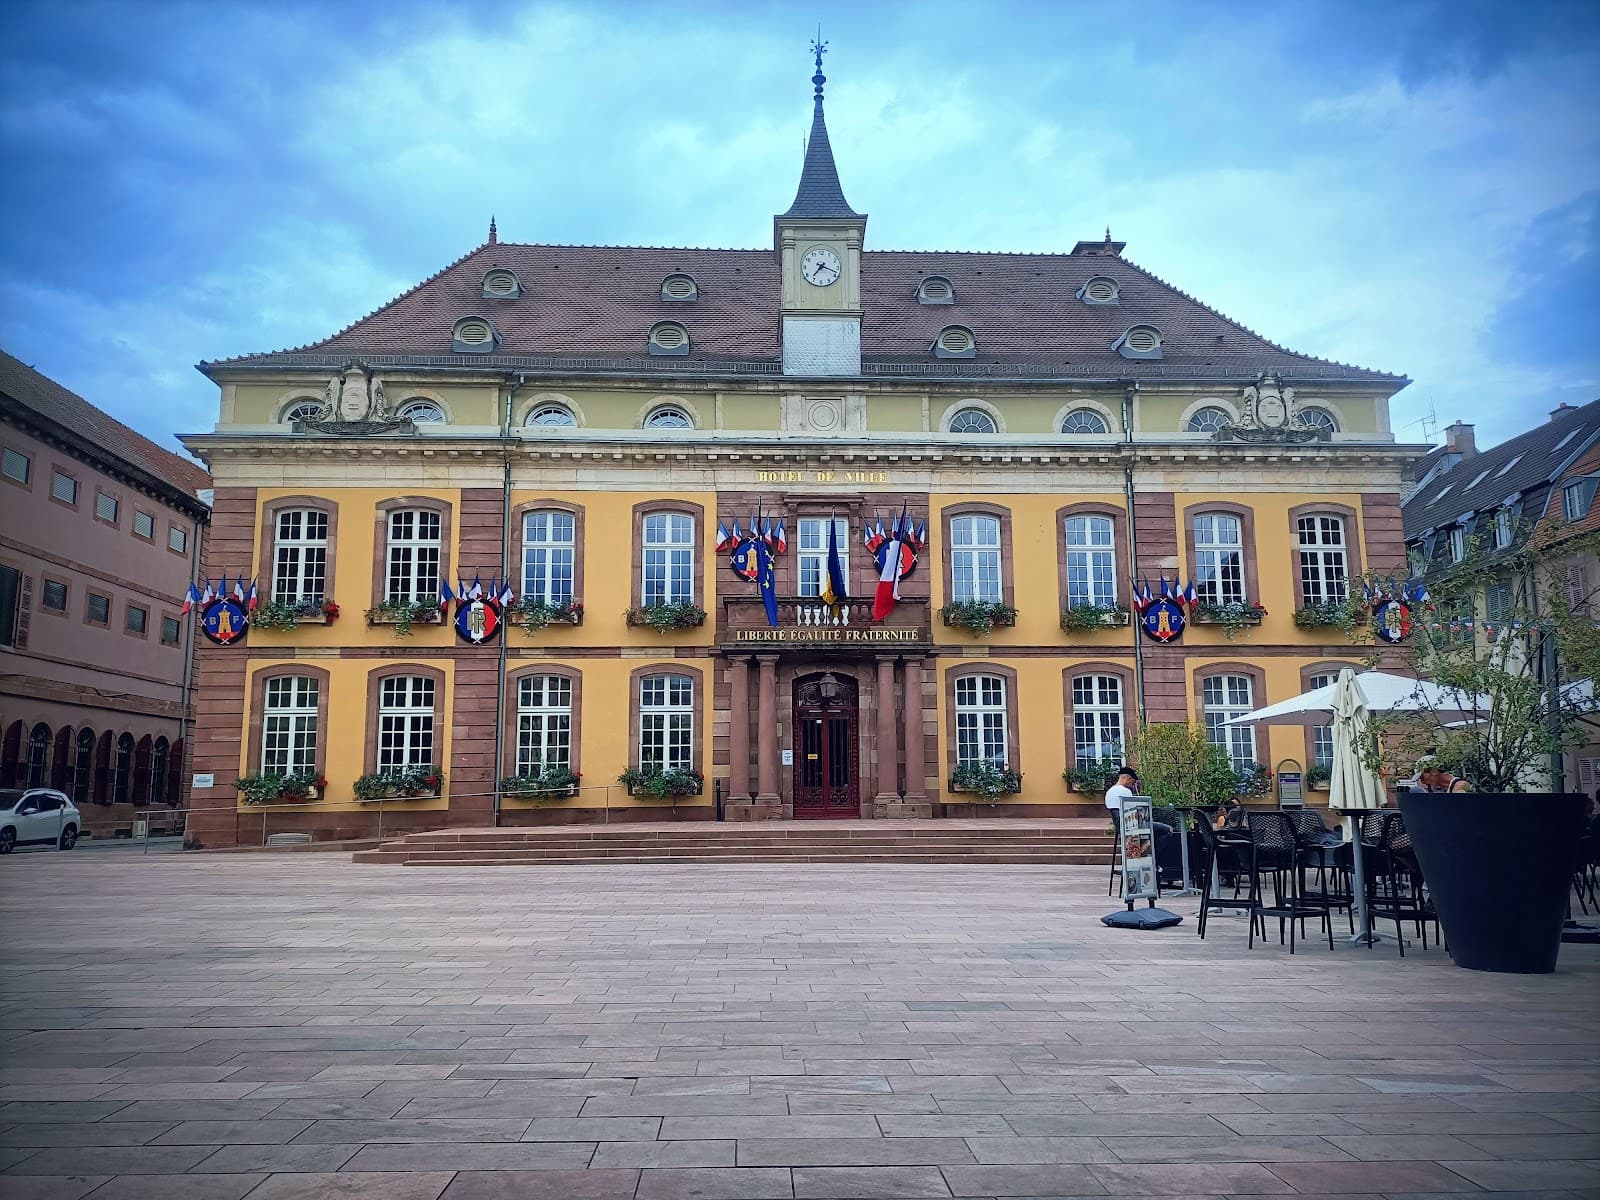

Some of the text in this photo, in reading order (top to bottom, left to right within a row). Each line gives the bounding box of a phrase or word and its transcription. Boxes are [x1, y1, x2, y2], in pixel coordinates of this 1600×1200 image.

[817, 471, 834, 482] DE
[845, 471, 887, 483] VILLE
[736, 629, 919, 641] LIBERTÉ ÉGALITÉ FRATERNITÉ
